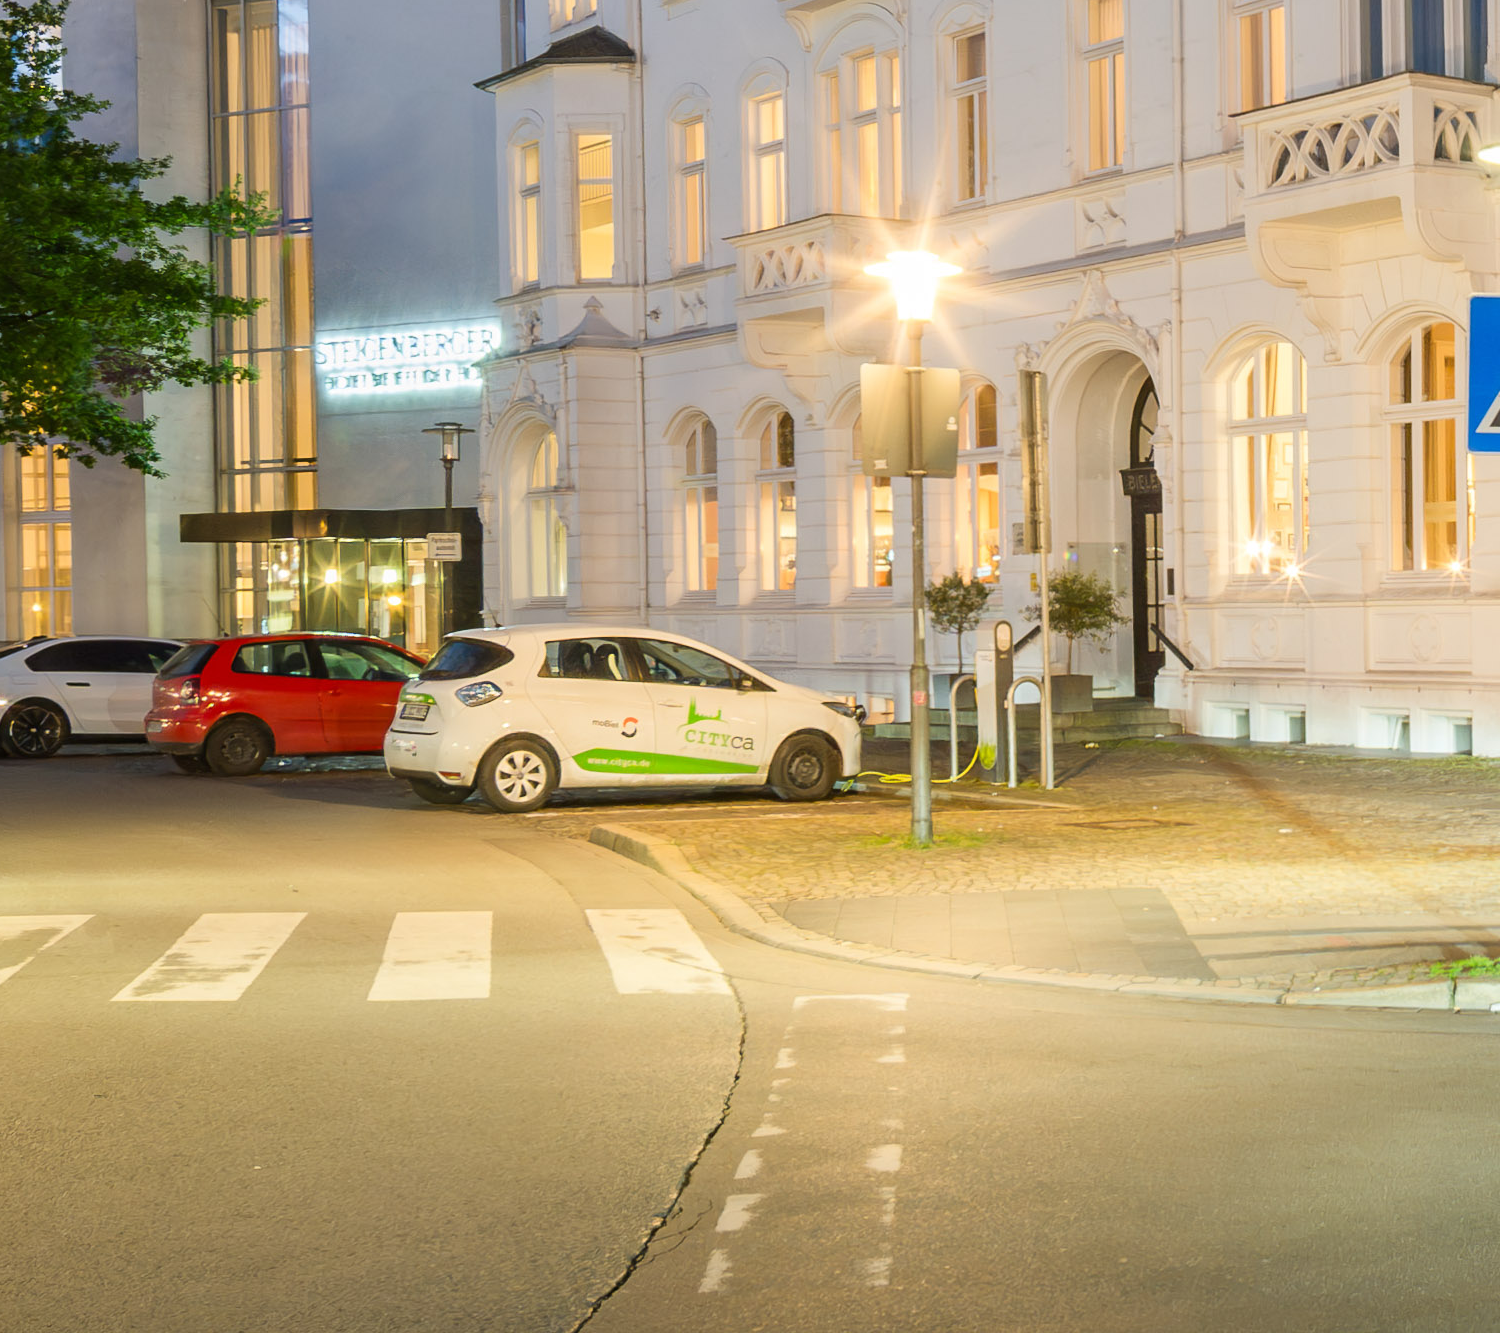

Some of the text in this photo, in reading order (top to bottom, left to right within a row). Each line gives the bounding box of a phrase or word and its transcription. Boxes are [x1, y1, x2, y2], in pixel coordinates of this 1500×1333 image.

[315, 329, 493, 365] STEIGENBERGER
[684, 729, 755, 752] CITYca
[586, 756, 652, 769] www.cityca.de
